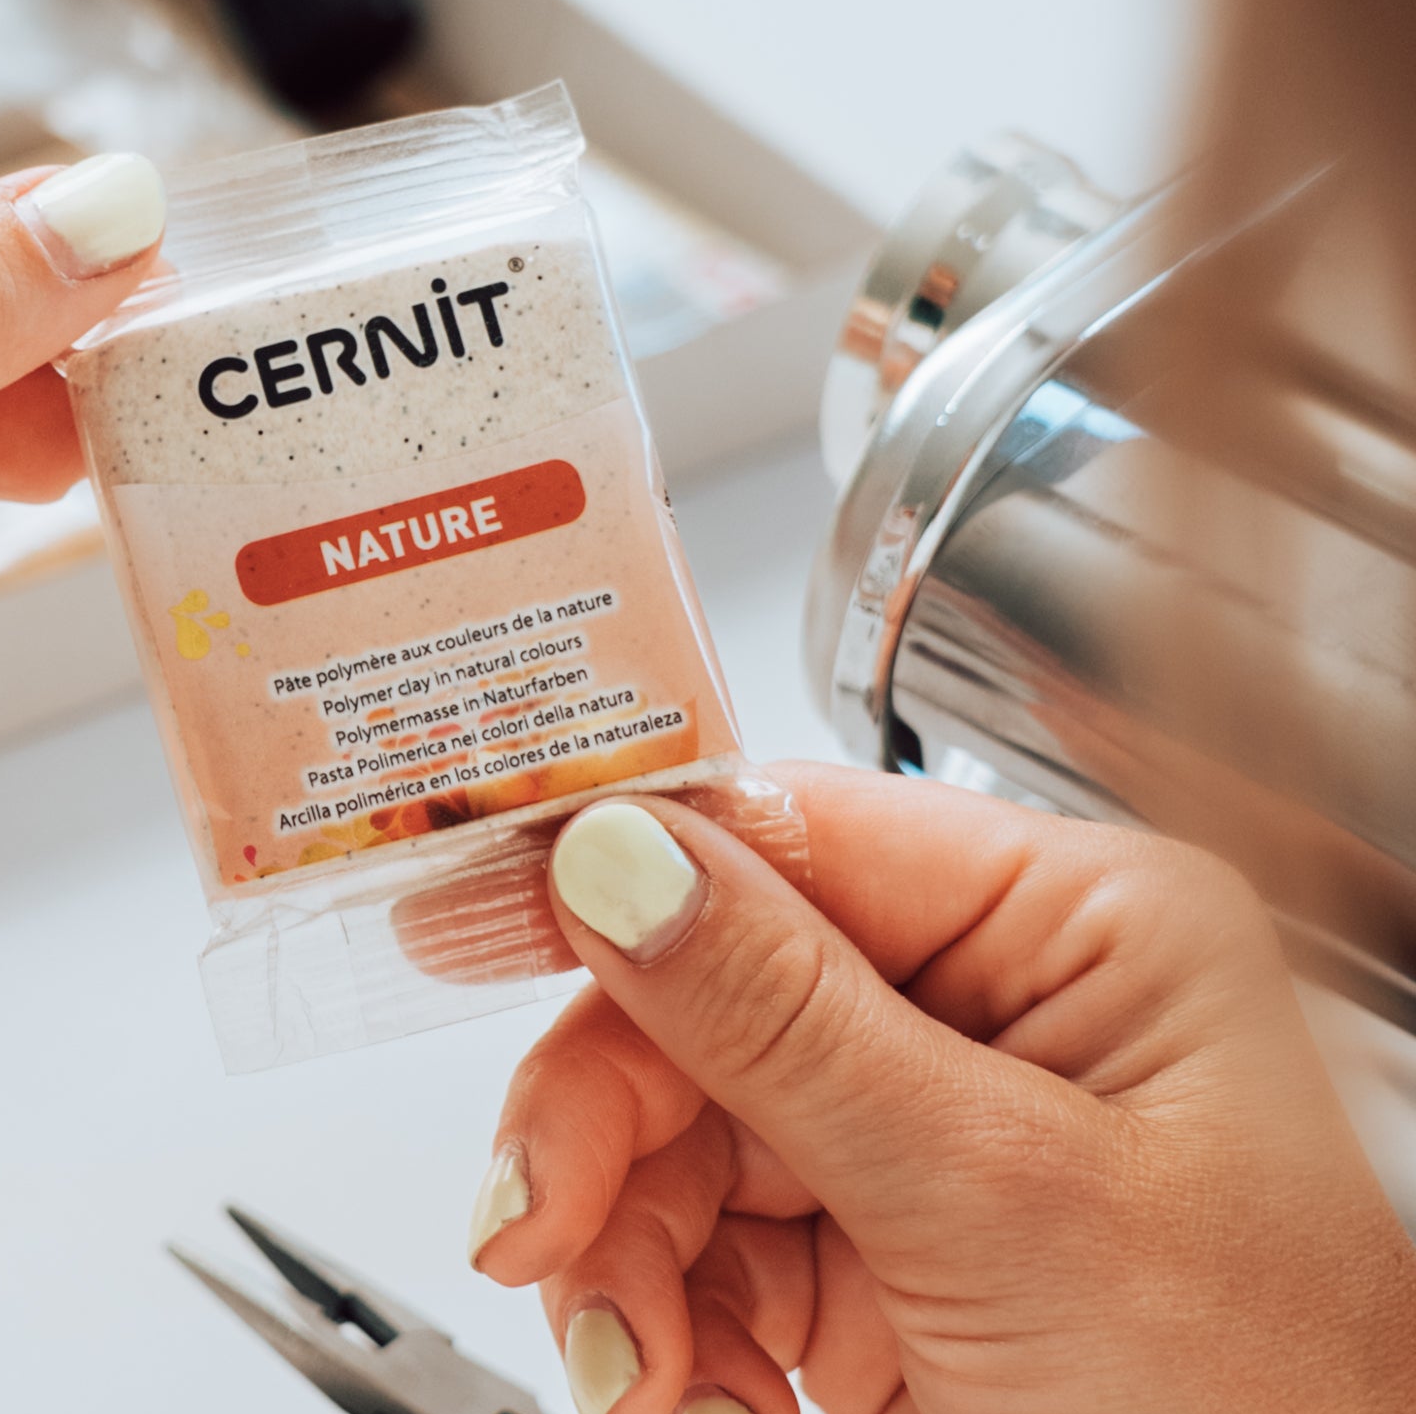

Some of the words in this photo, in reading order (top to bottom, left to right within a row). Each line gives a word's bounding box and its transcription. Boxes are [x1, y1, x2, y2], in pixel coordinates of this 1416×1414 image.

[319, 496, 503, 576] NATURE
[273, 674, 312, 695] Pâte
[317, 651, 397, 688] polymère
[402, 644, 432, 661] aux
[436, 621, 508, 652] couleurs
[512, 614, 533, 631] de
[538, 608, 552, 625] la
[557, 593, 613, 620] nature
[323, 686, 392, 716] Polymer
[398, 674, 430, 699] clay
[435, 670, 451, 687] in
[456, 651, 516, 680] natural
[520, 634, 582, 664] colours
[308, 767, 353, 788] Pasta
[358, 739, 447, 775] Polimerica
[452, 731, 478, 748] nei
[482, 715, 529, 742] colori
[534, 704, 574, 729] della
[579, 690, 633, 714] natura
[336, 703, 459, 747] Polymermasse
[463, 696, 479, 713] in
[484, 667, 588, 708] Naturfarben
[279, 804, 331, 830] Arcilla
[337, 778, 425, 817] polimérica
[429, 774, 451, 789] en
[455, 764, 480, 784] los
[485, 747, 545, 777] colores
[549, 739, 571, 757] de
[575, 734, 589, 749] la
[594, 710, 682, 745] naturaleza
